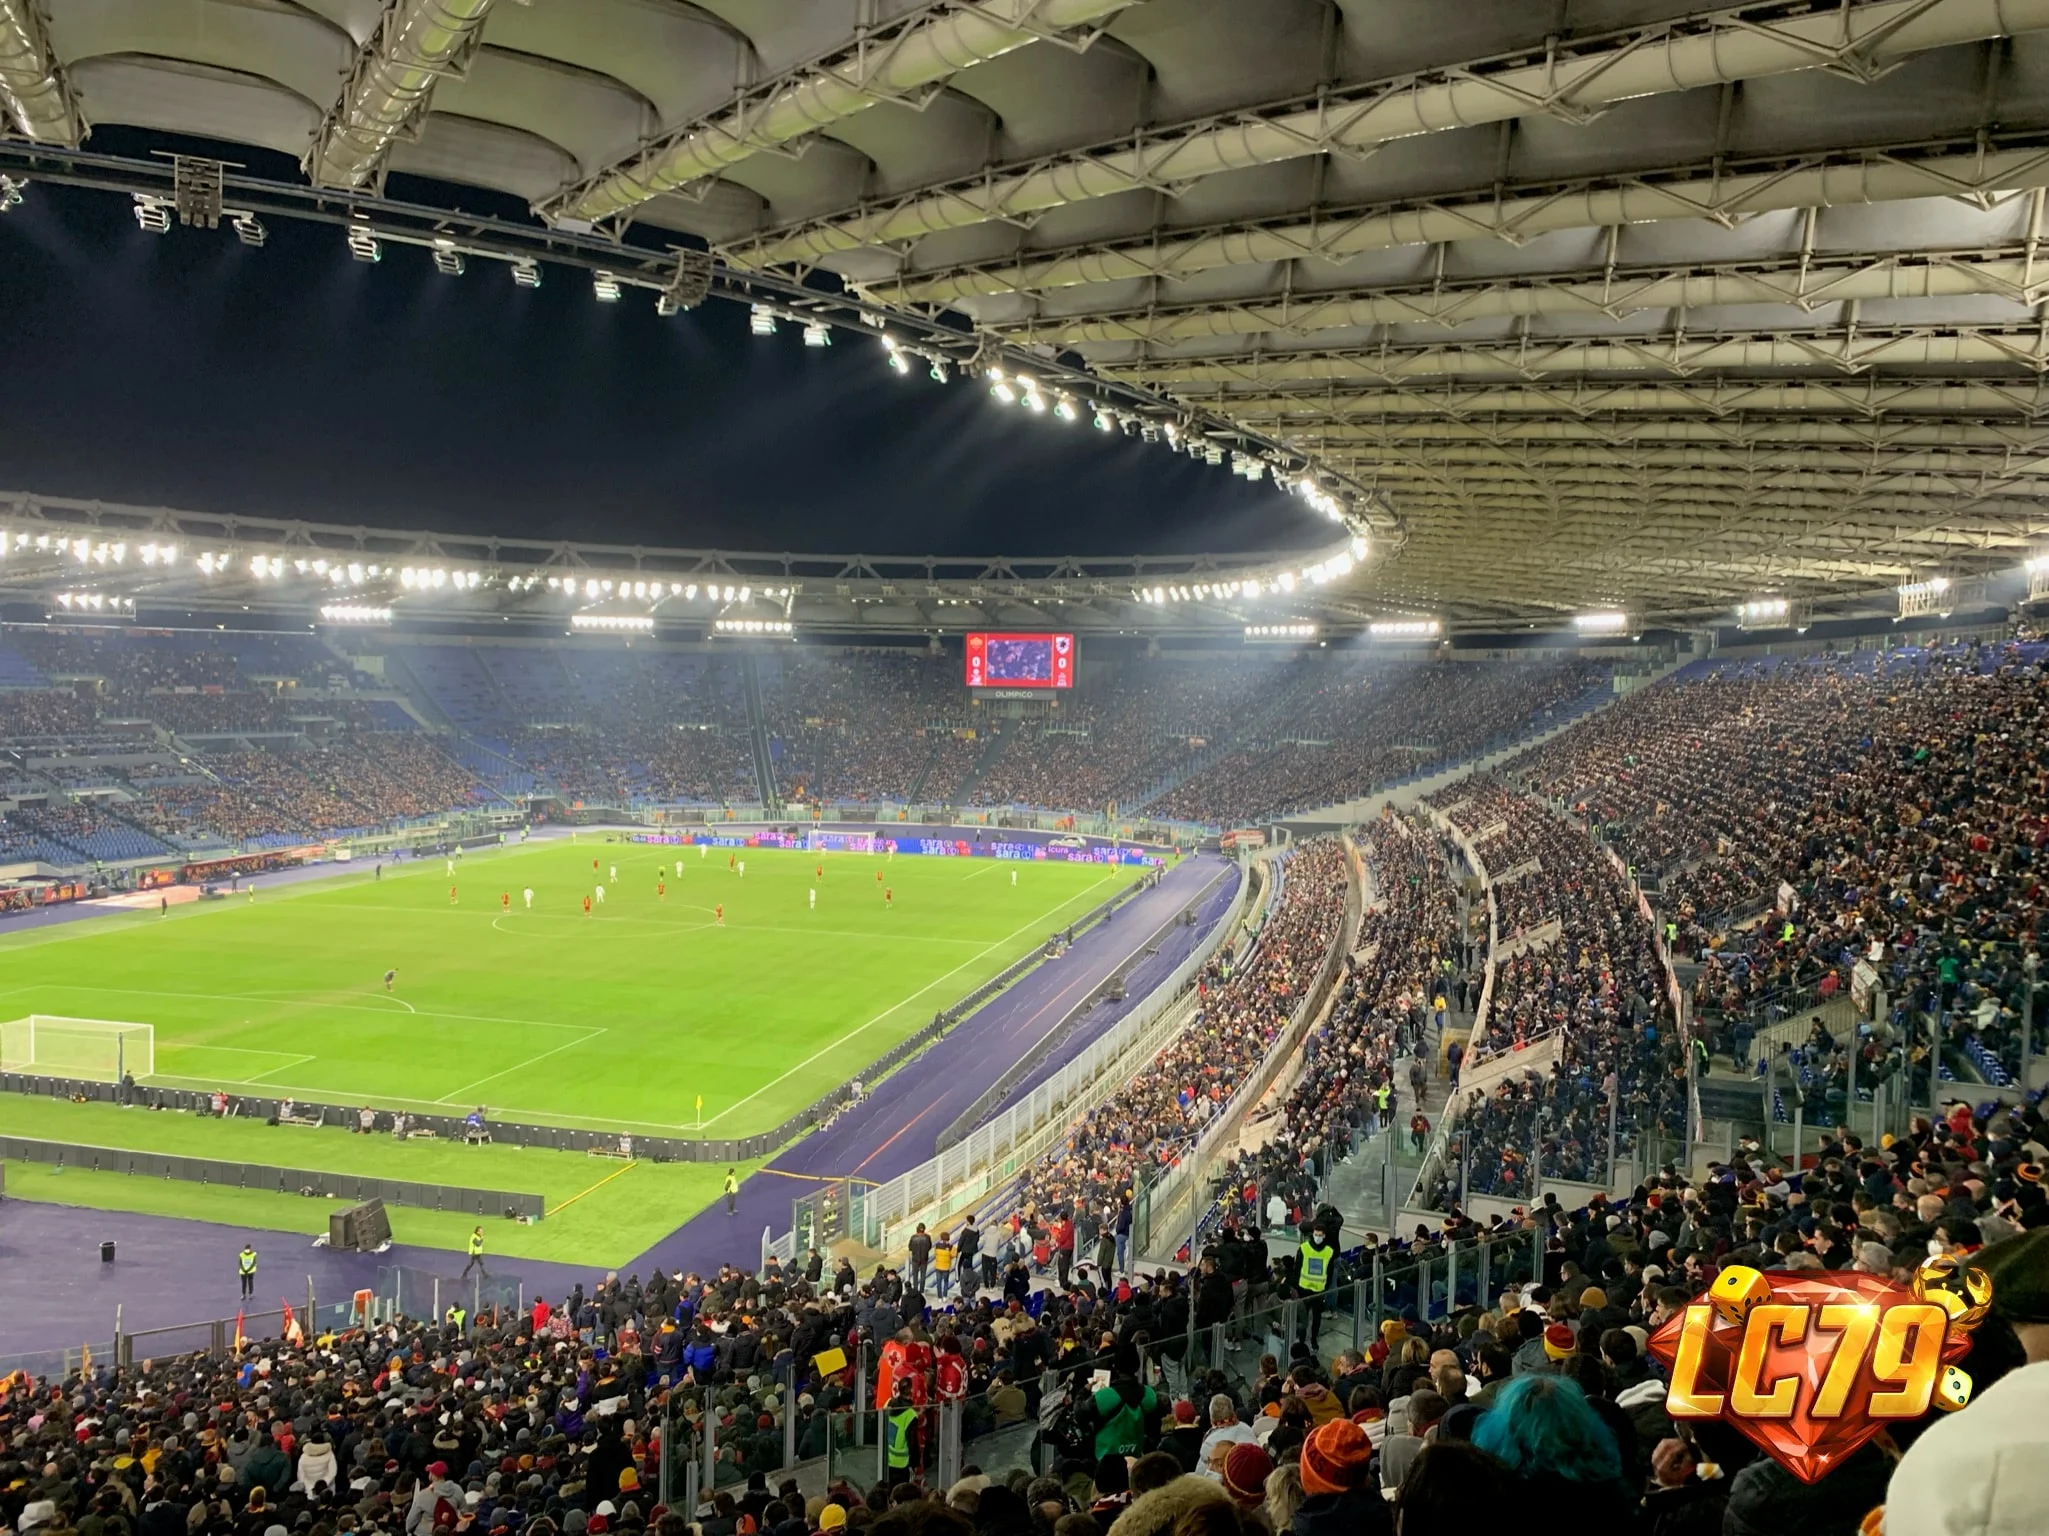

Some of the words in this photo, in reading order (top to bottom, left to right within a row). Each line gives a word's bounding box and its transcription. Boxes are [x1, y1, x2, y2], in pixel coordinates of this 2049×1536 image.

[972, 656, 981, 667] 0
[1058, 658, 1067, 669] 0
[995, 690, 1033, 698] OLIMPICO
[712, 837, 735, 847] sara
[922, 846, 946, 856] sara
[996, 848, 1021, 859] sara
[1093, 846, 1118, 856] sara
[1067, 852, 1093, 863] sara
